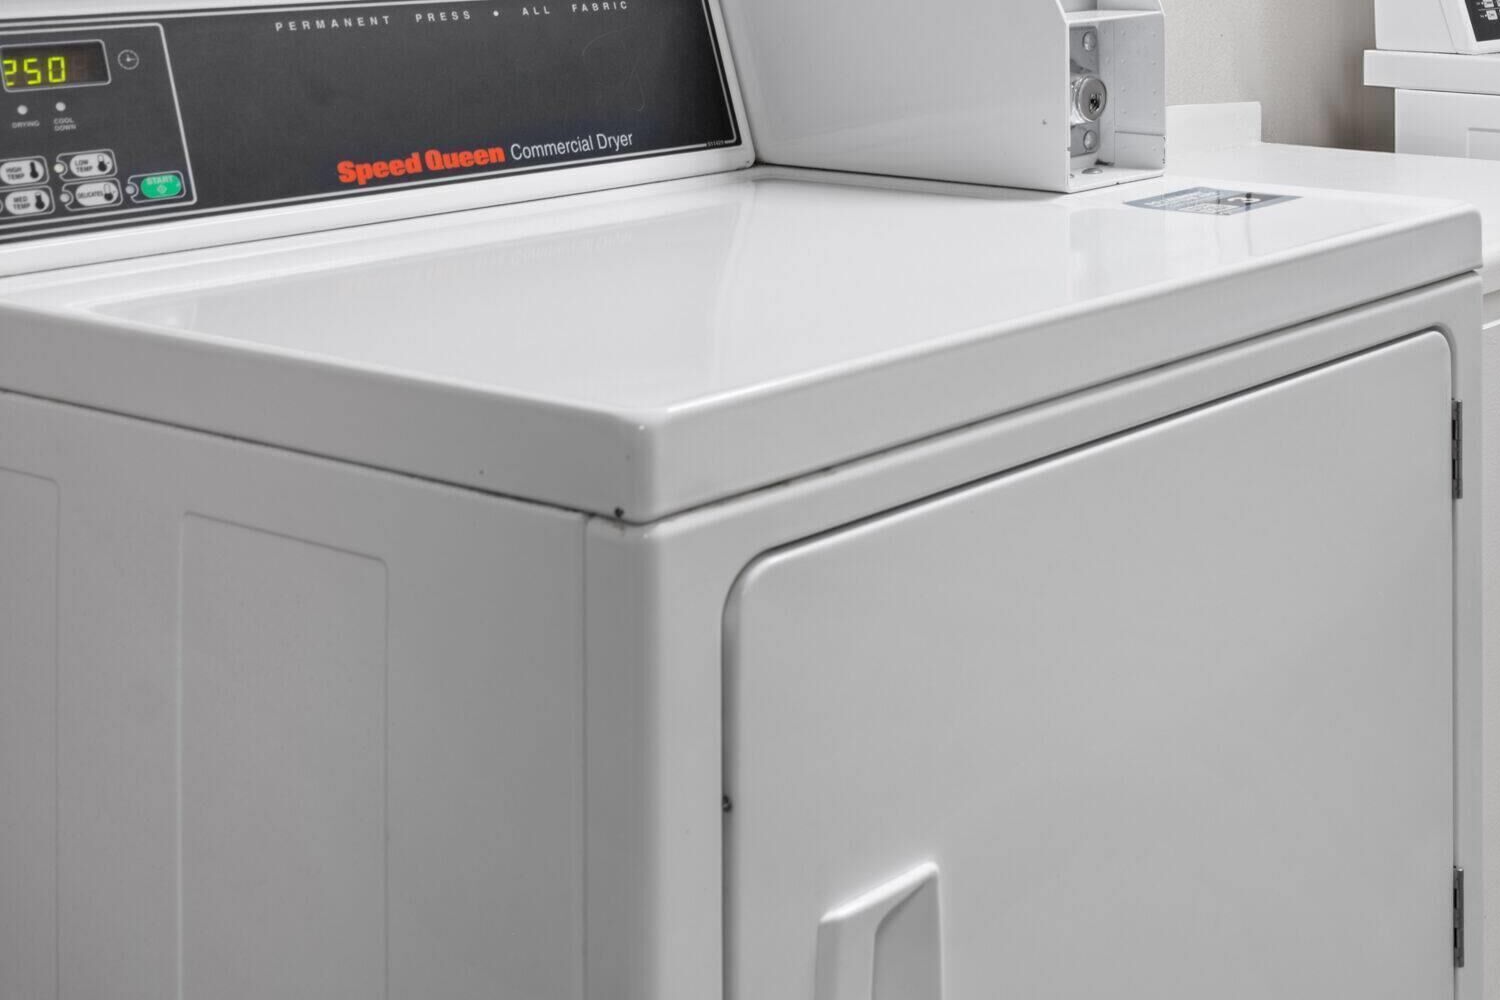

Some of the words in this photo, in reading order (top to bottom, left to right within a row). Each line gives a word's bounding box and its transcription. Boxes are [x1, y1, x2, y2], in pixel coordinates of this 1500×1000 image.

[275, 15, 391, 32] PERMANENT
[415, 10, 472, 23] PRESS
[521, 5, 551, 17] ALL
[571, 0, 629, 13] FABRIC
[12, 120, 40, 129] DRYING
[53, 117, 74, 125] COOL
[336, 156, 421, 186] Speed
[424, 144, 506, 173] Queen
[510, 134, 594, 161] Commercial
[597, 131, 633, 154] Dryer
